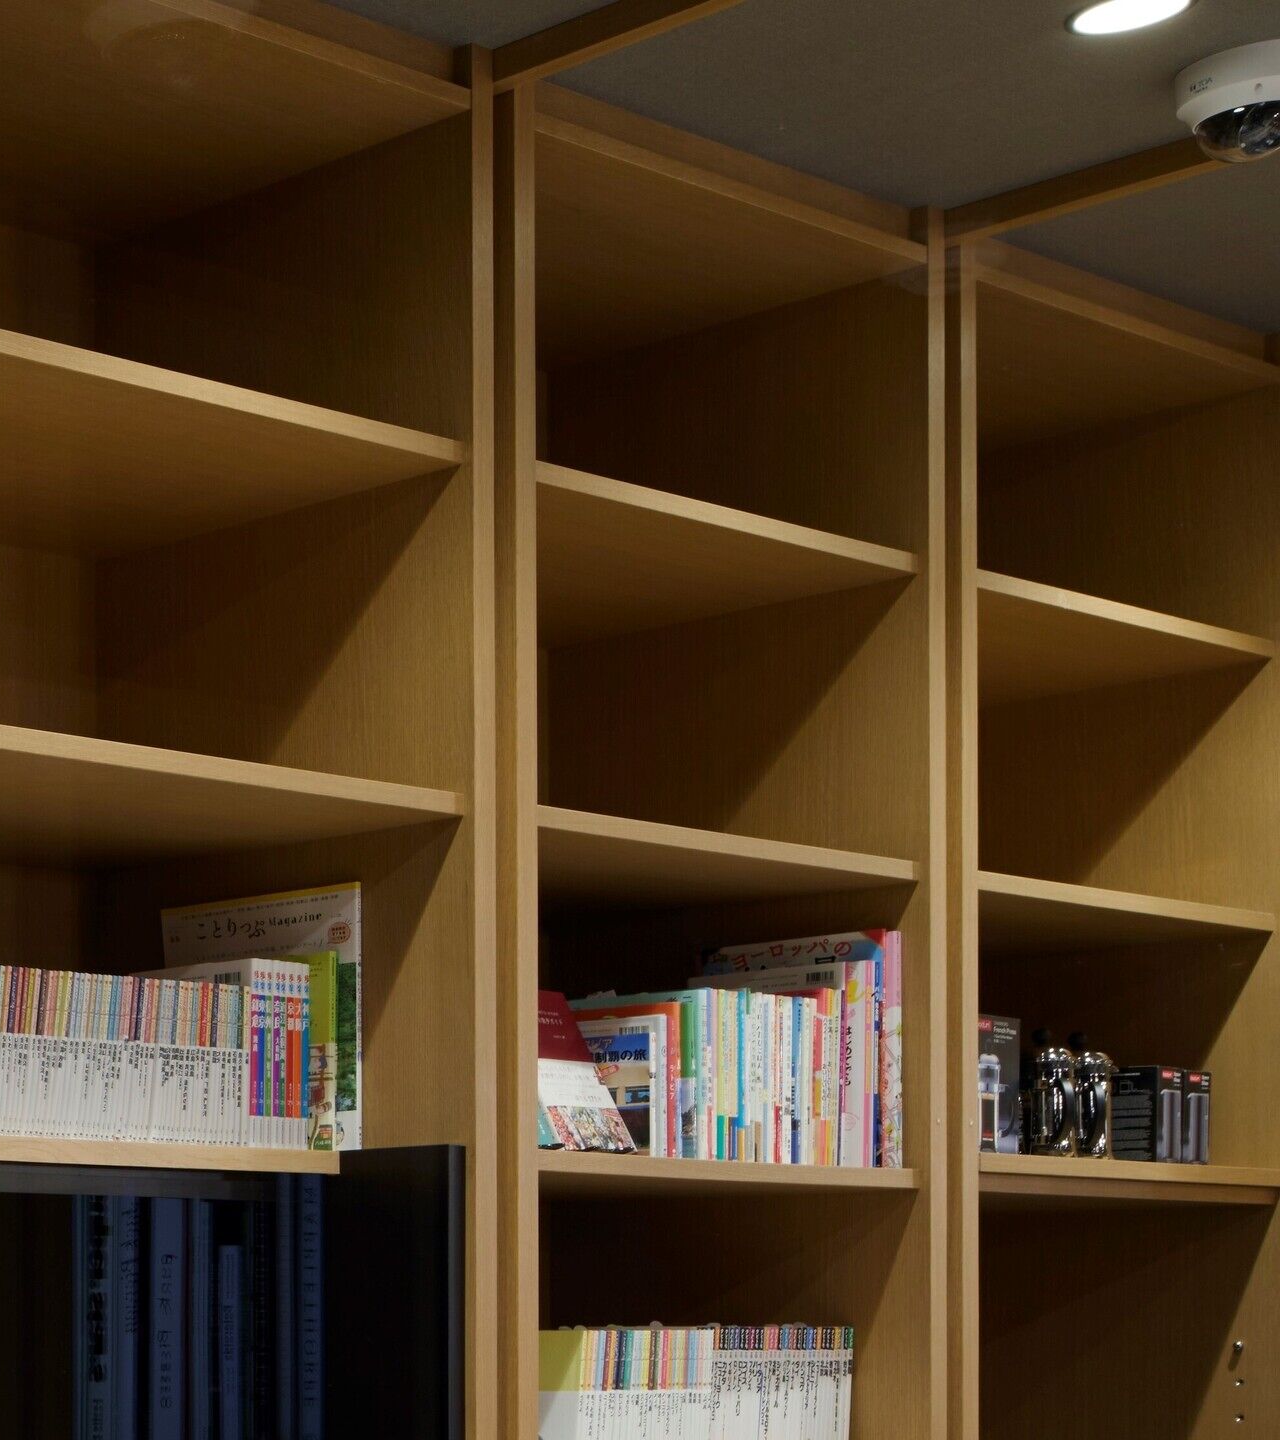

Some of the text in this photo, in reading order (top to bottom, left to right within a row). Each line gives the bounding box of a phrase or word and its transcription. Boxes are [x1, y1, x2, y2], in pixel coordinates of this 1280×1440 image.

[197, 912, 322, 940] ことりっぷ Magazine
[730, 938, 852, 970] ヨーロッパの
